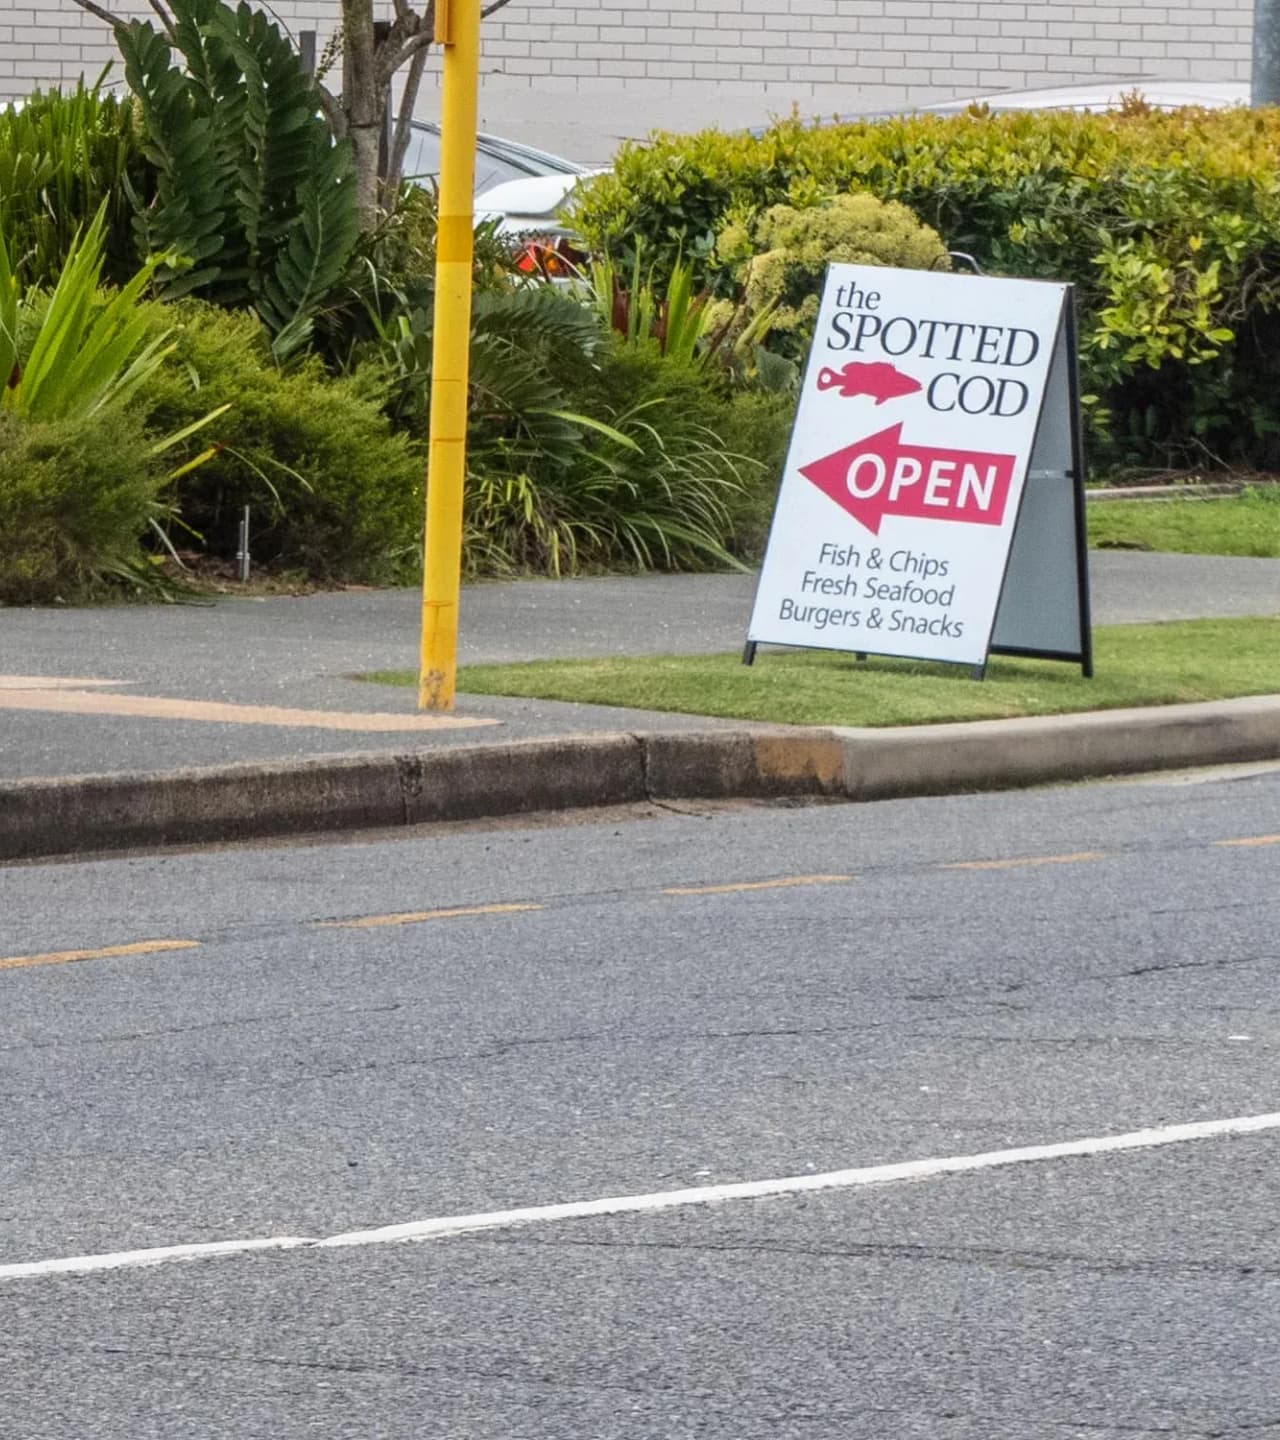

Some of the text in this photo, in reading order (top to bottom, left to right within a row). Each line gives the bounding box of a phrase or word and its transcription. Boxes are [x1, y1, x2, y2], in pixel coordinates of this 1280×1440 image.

[835, 281, 881, 311] the
[826, 311, 1040, 368] SPOTTED
[925, 372, 1030, 418] COD
[845, 452, 998, 512] OPEN
[819, 542, 949, 578] Fish & Chips
[801, 570, 955, 607] Fresh Seafood
[778, 598, 964, 639] Burgers & Snacks
